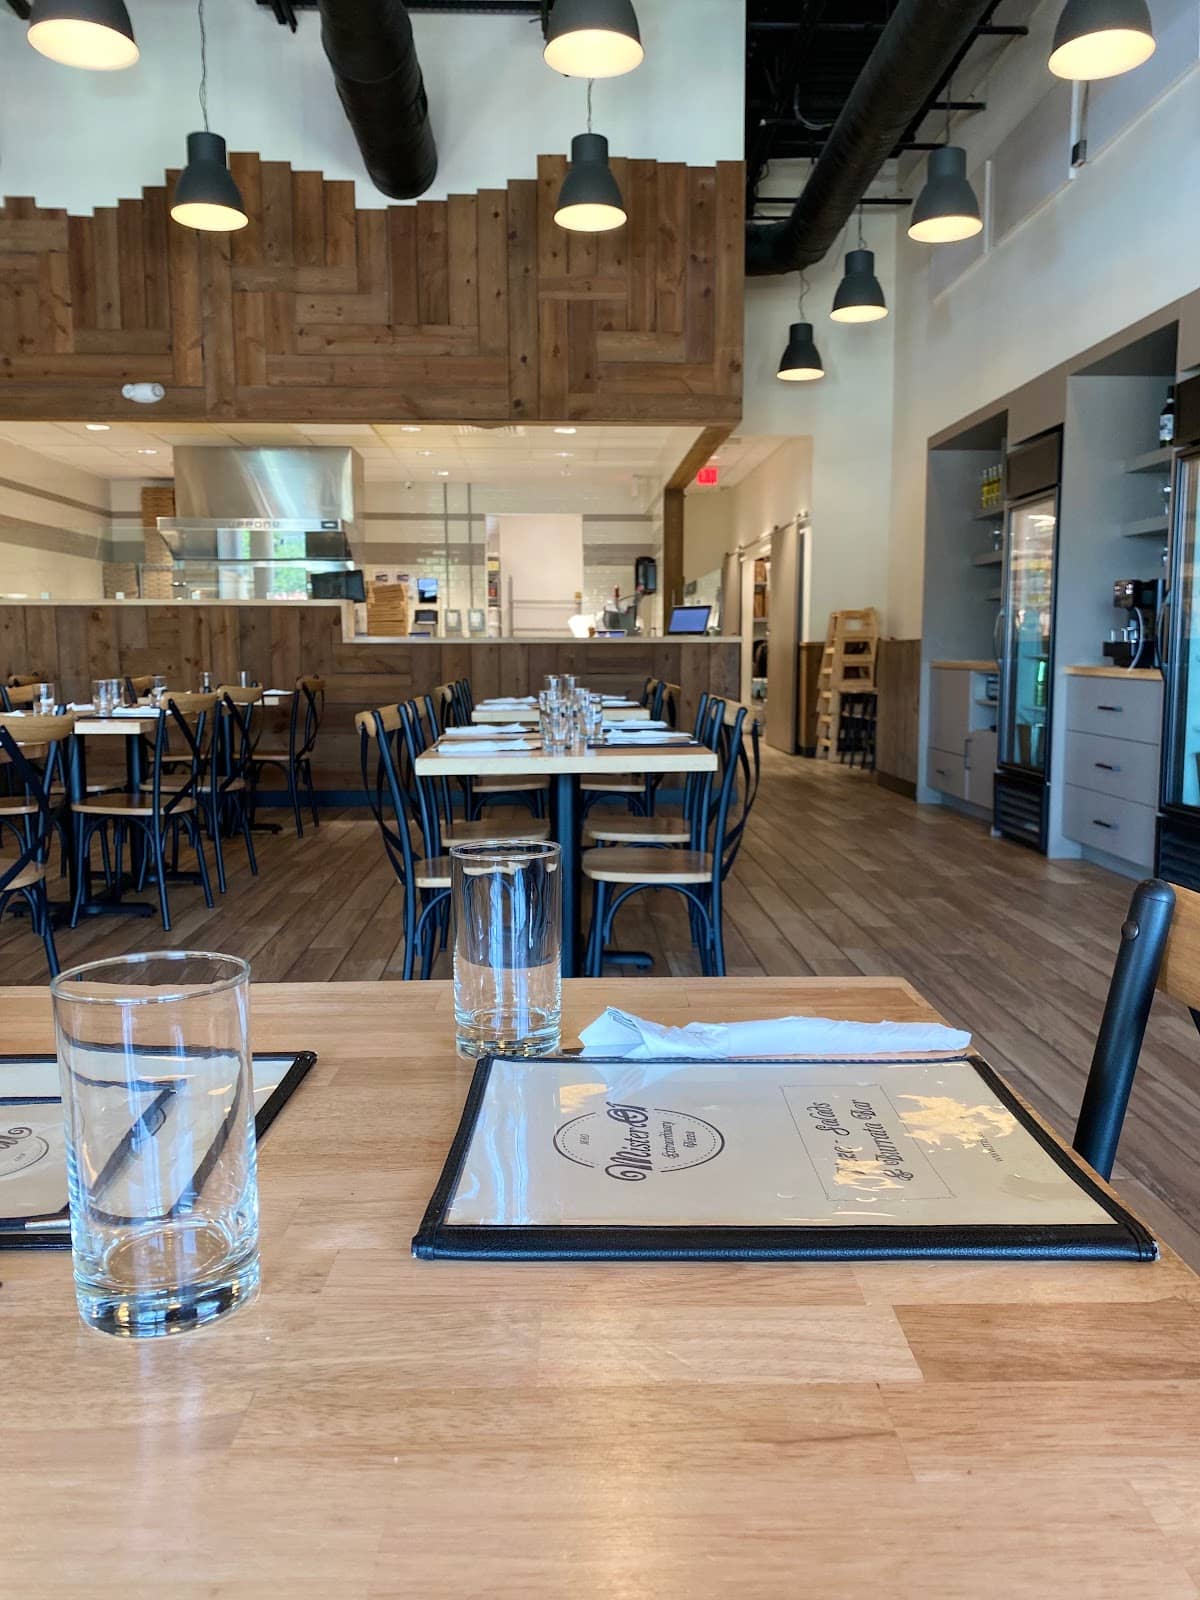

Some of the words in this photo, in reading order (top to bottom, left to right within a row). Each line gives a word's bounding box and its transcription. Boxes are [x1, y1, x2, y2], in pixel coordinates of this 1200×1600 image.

[806, 1101, 850, 1136] Salads
[849, 1099, 877, 1120] Bar
[862, 1122, 904, 1166] Burrata
